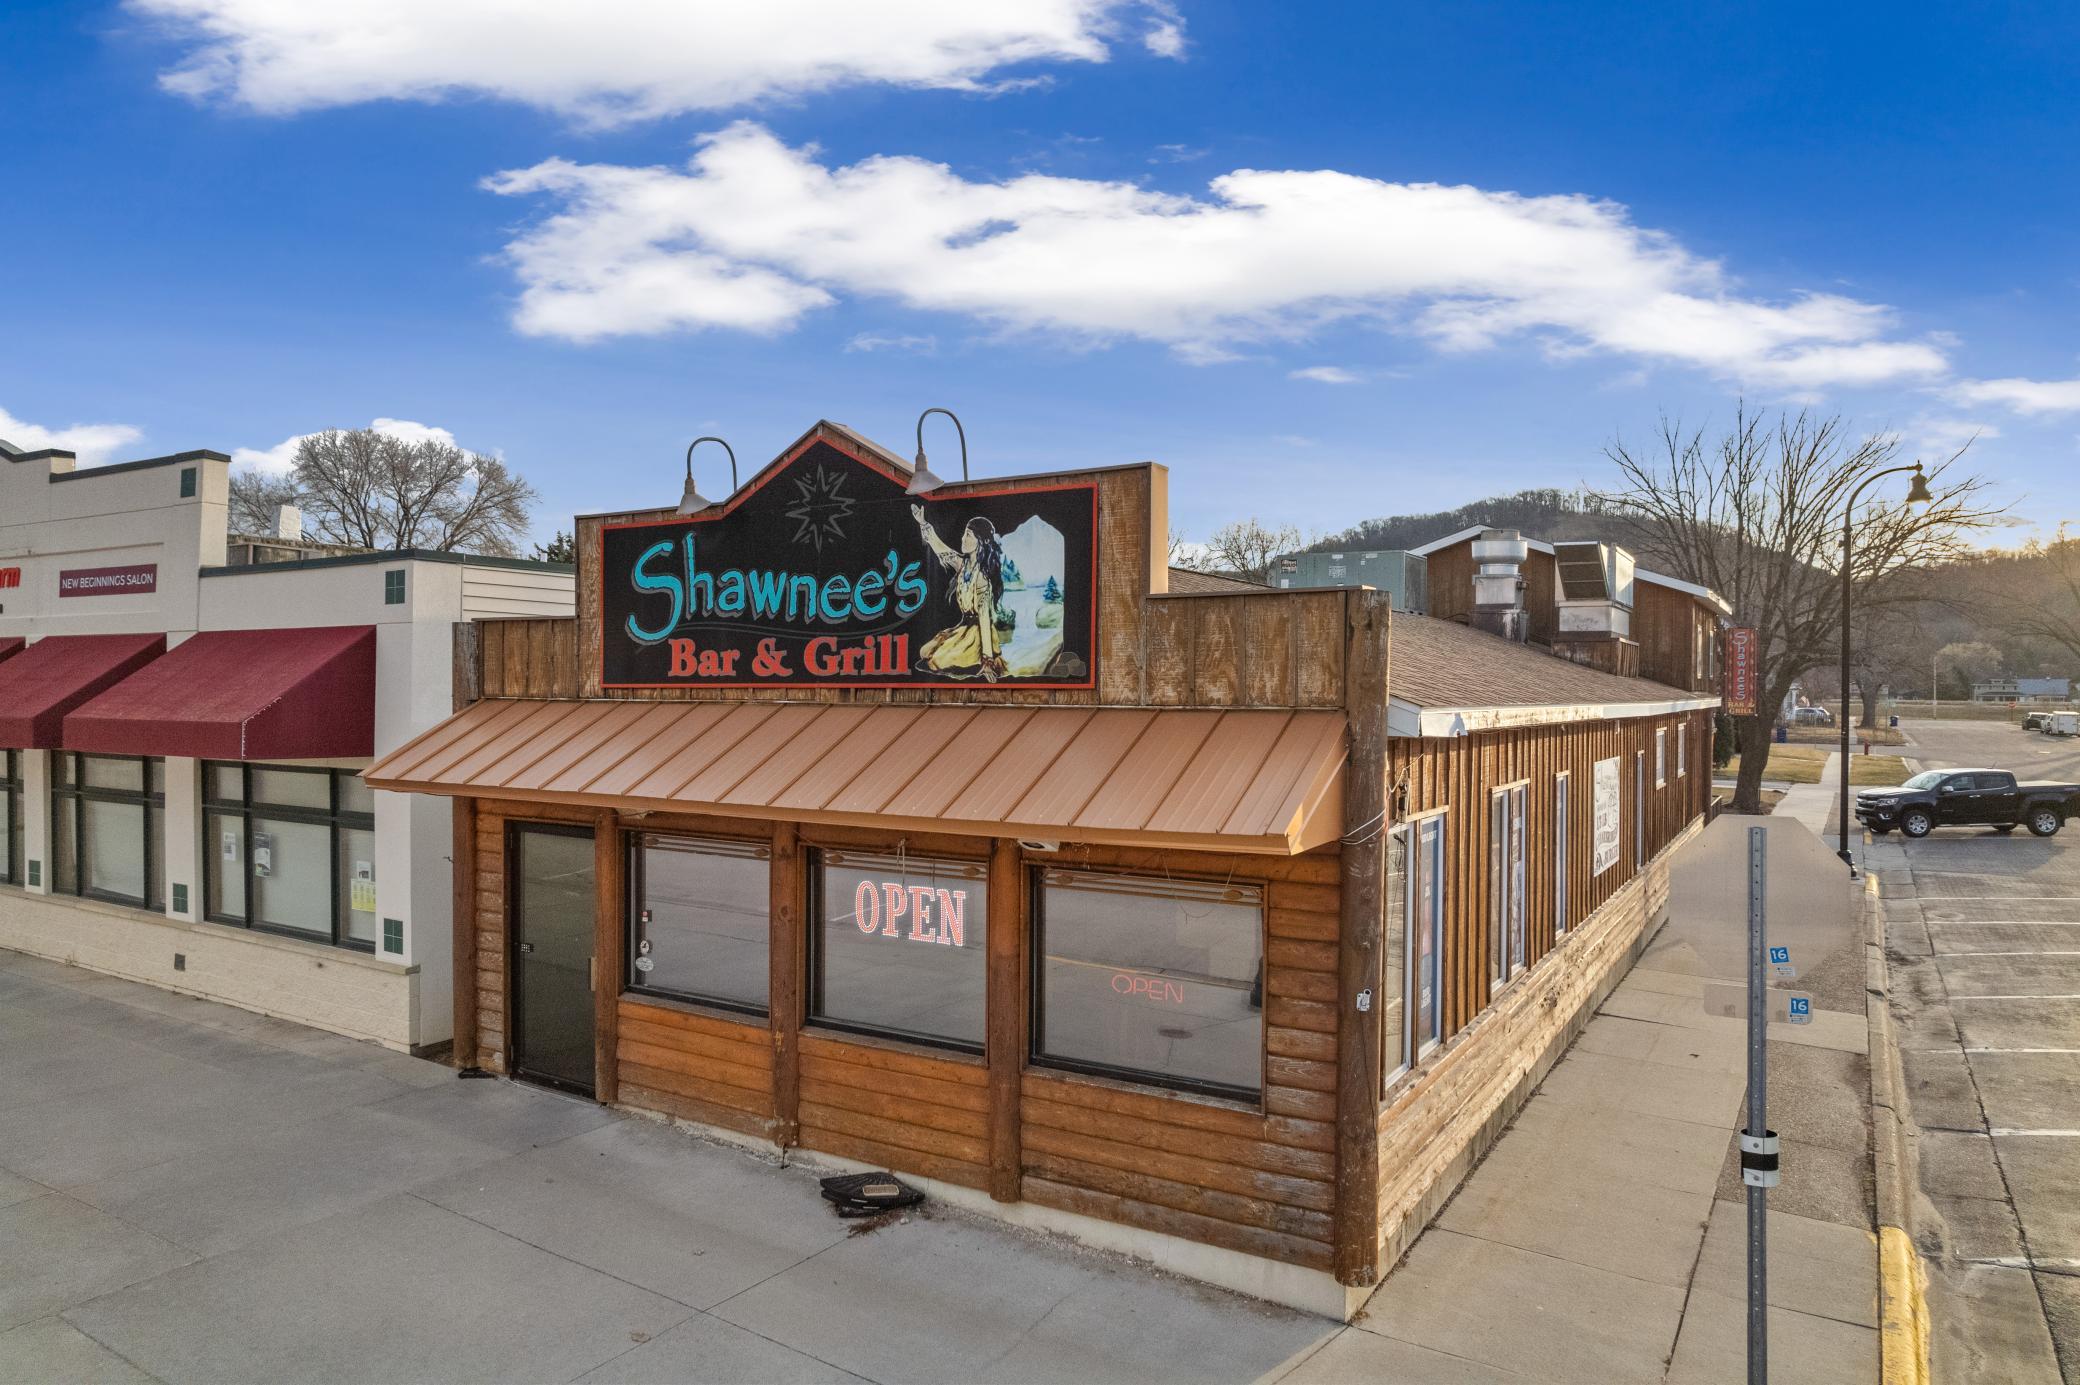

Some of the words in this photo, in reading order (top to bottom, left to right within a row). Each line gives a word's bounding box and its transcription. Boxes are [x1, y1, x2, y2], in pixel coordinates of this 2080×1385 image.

[62, 578, 79, 589] NEW
[80, 575, 125, 588] BEGINNINGS
[126, 573, 154, 584] SALON
[627, 532, 928, 644] Shawnee's
[668, 638, 740, 677] Bar
[752, 637, 793, 677] &
[803, 633, 912, 676] Grill
[855, 880, 967, 947] OPEN
[1771, 949, 1787, 960] 16
[1111, 974, 1184, 1004] OPEN
[1792, 1000, 1807, 1011] 16
